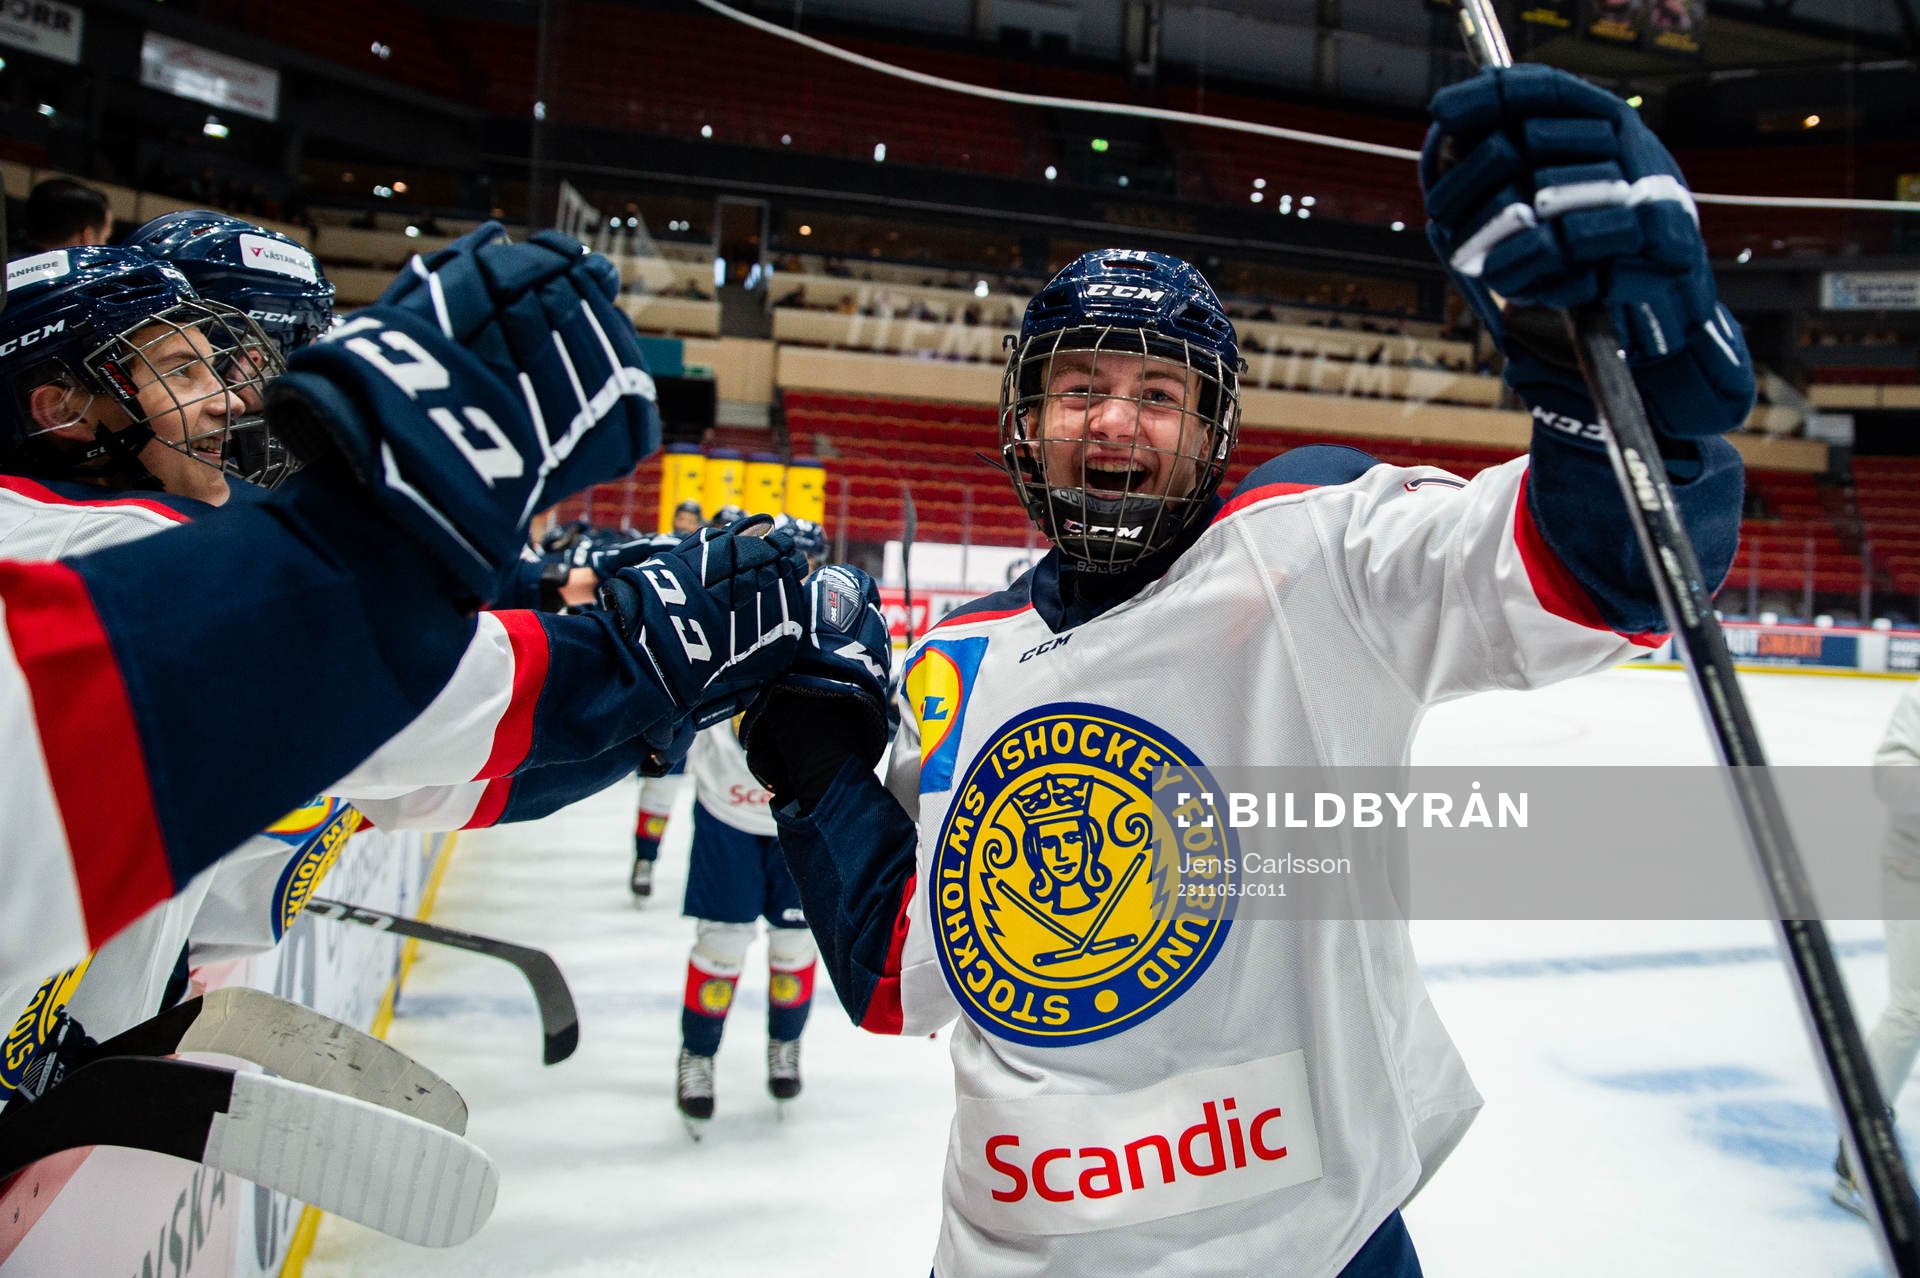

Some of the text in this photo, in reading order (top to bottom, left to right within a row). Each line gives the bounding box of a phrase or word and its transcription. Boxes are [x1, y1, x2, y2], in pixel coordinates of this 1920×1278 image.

[7, 261, 59, 279] ANHEDE
[1086, 284, 1165, 302] CCM
[247, 309, 297, 324] CCM
[0, 319, 66, 357] CCM
[1019, 633, 1074, 664] CCM
[941, 721, 1215, 1026] STOCKHOLMS ISHOCKEY FÖRBUND
[985, 1097, 1288, 1203] Scandic
